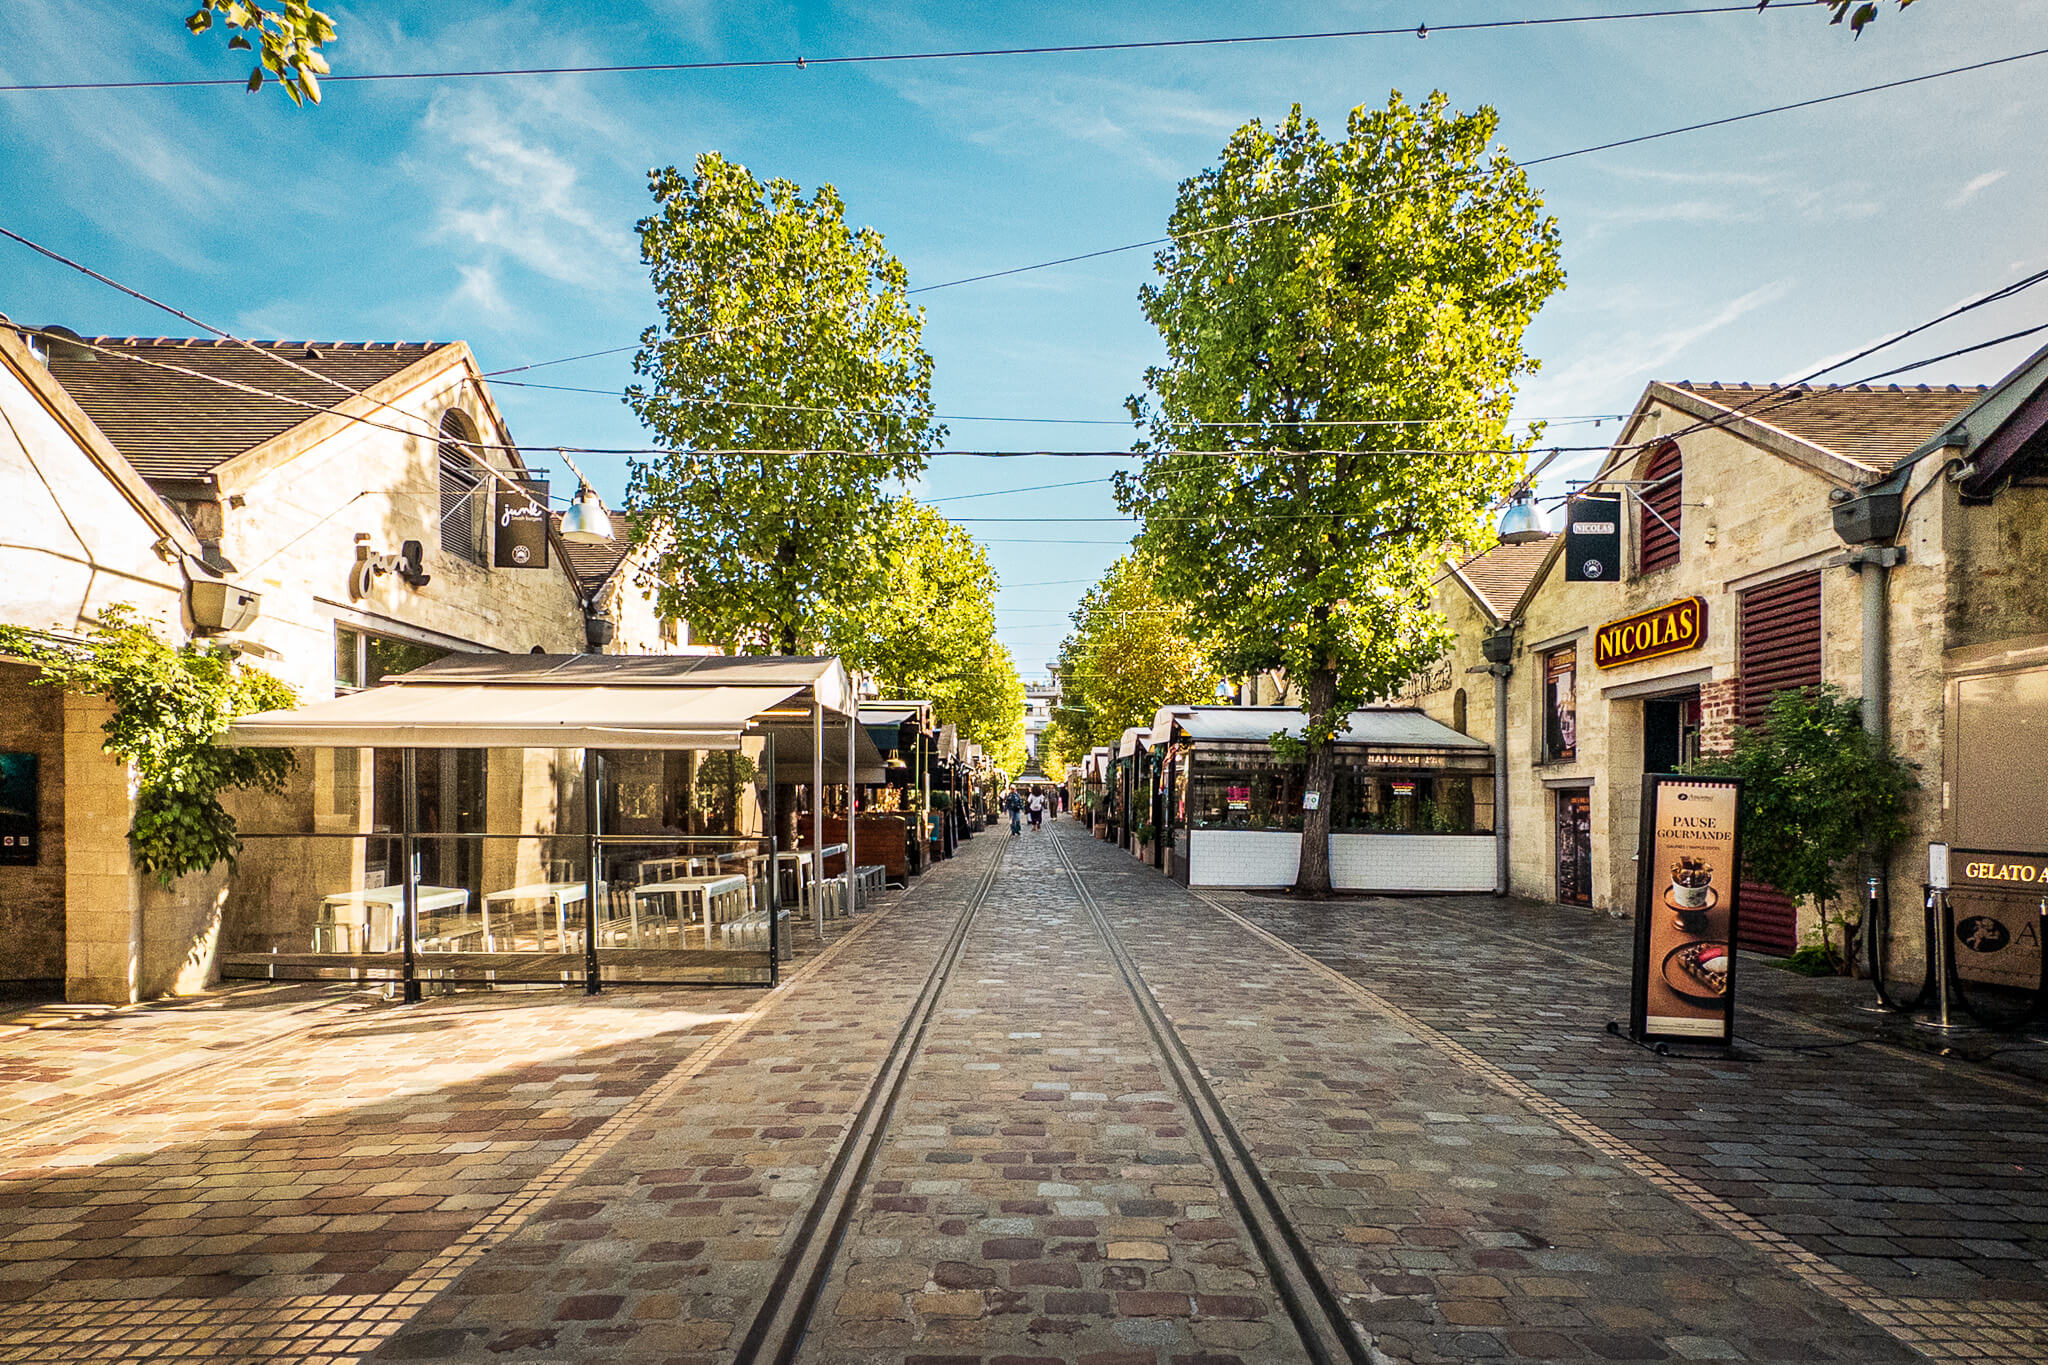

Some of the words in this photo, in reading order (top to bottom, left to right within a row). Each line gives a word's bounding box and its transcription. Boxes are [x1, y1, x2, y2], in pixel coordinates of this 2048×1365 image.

[501, 502, 542, 527] junk
[1575, 524, 1613, 533] NICOLAS
[1599, 608, 1693, 661] NICOLAS
[1673, 816, 1716, 828] PAUSE
[1657, 829, 1732, 841] GOURMANDE
[1965, 862, 2036, 882] GELATO
